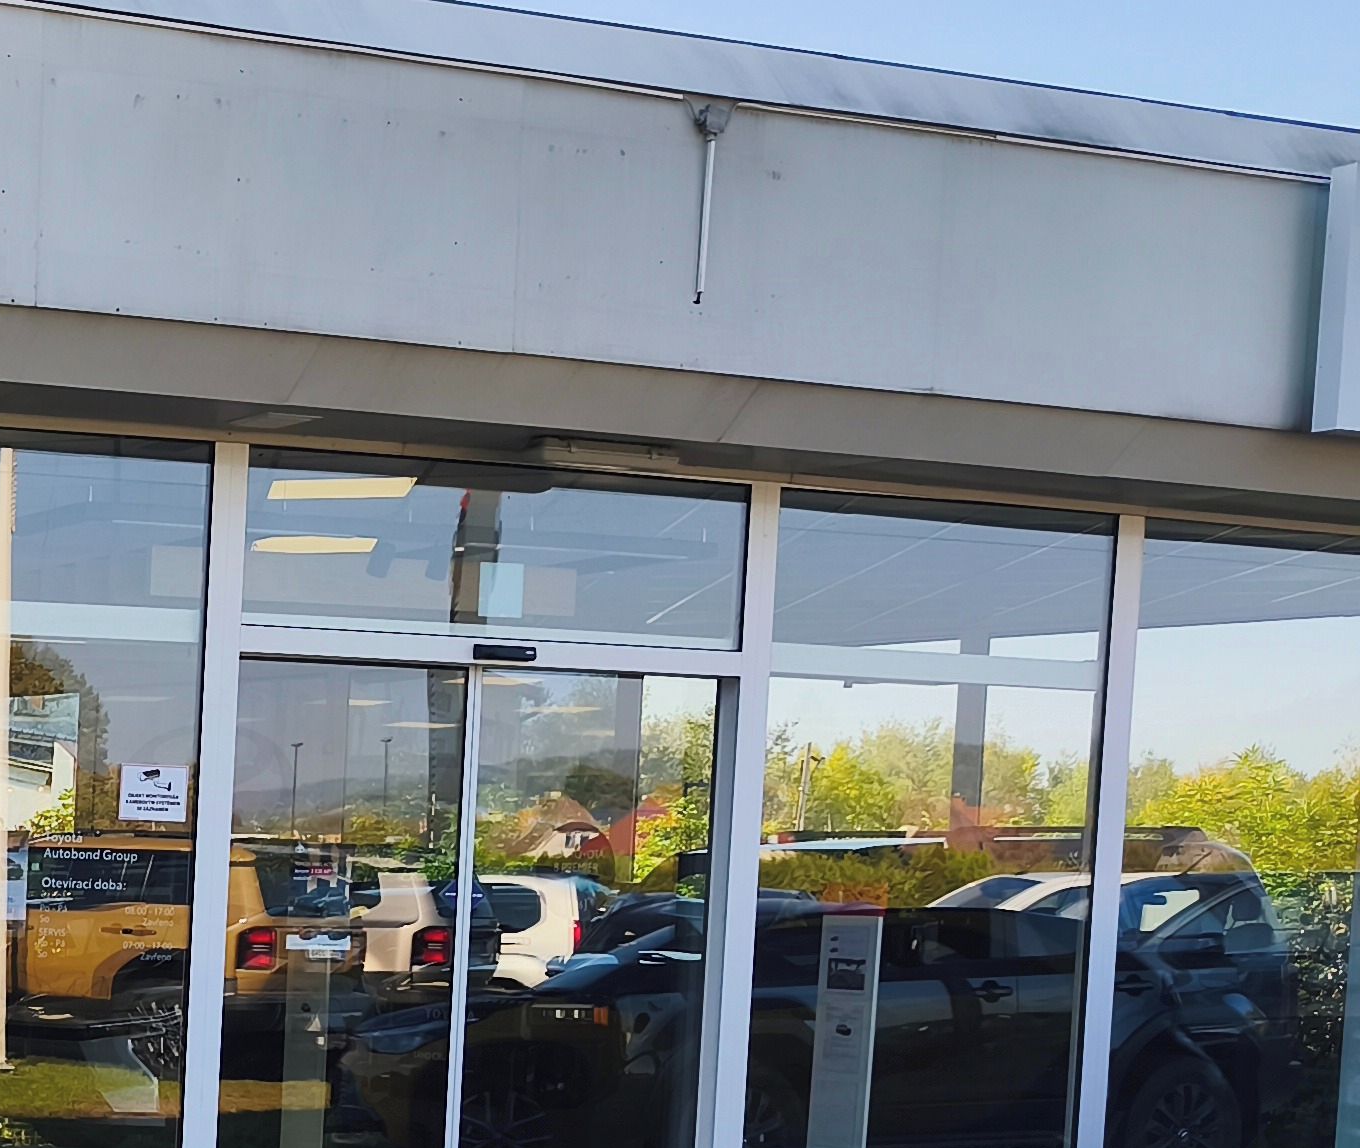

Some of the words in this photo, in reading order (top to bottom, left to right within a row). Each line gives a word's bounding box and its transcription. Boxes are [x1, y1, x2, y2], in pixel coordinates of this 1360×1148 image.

[43, 848, 100, 861] Autobond
[102, 850, 138, 863] Group
[41, 876, 93, 889] Otevírací
[94, 878, 127, 891] doba:
